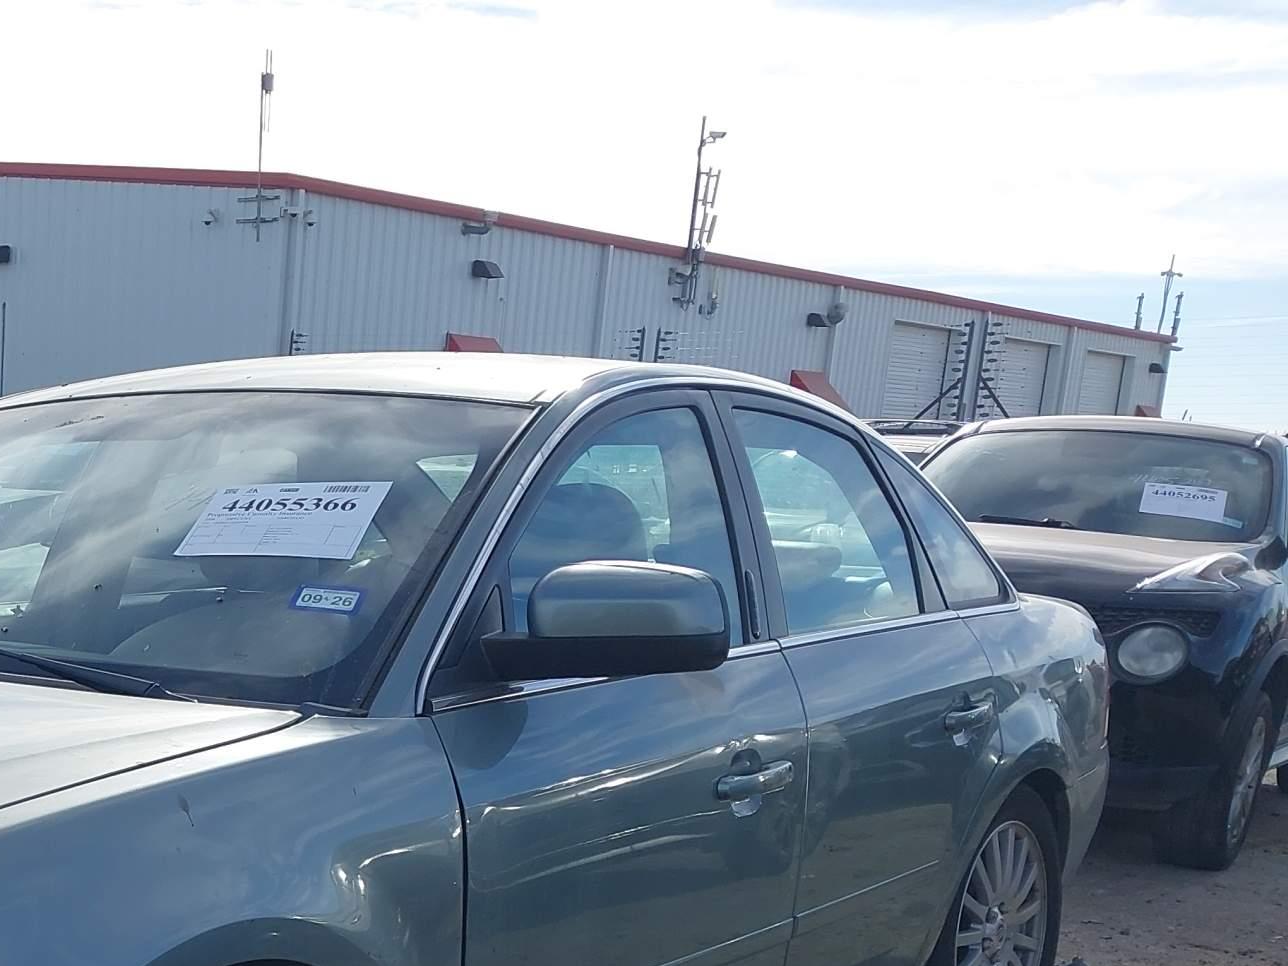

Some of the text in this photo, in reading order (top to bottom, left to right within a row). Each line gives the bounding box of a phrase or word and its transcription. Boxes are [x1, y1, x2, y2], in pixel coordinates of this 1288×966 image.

[1152, 489, 1217, 502] 44052695
[222, 497, 360, 512] 44055366
[301, 593, 354, 607] 09 26
